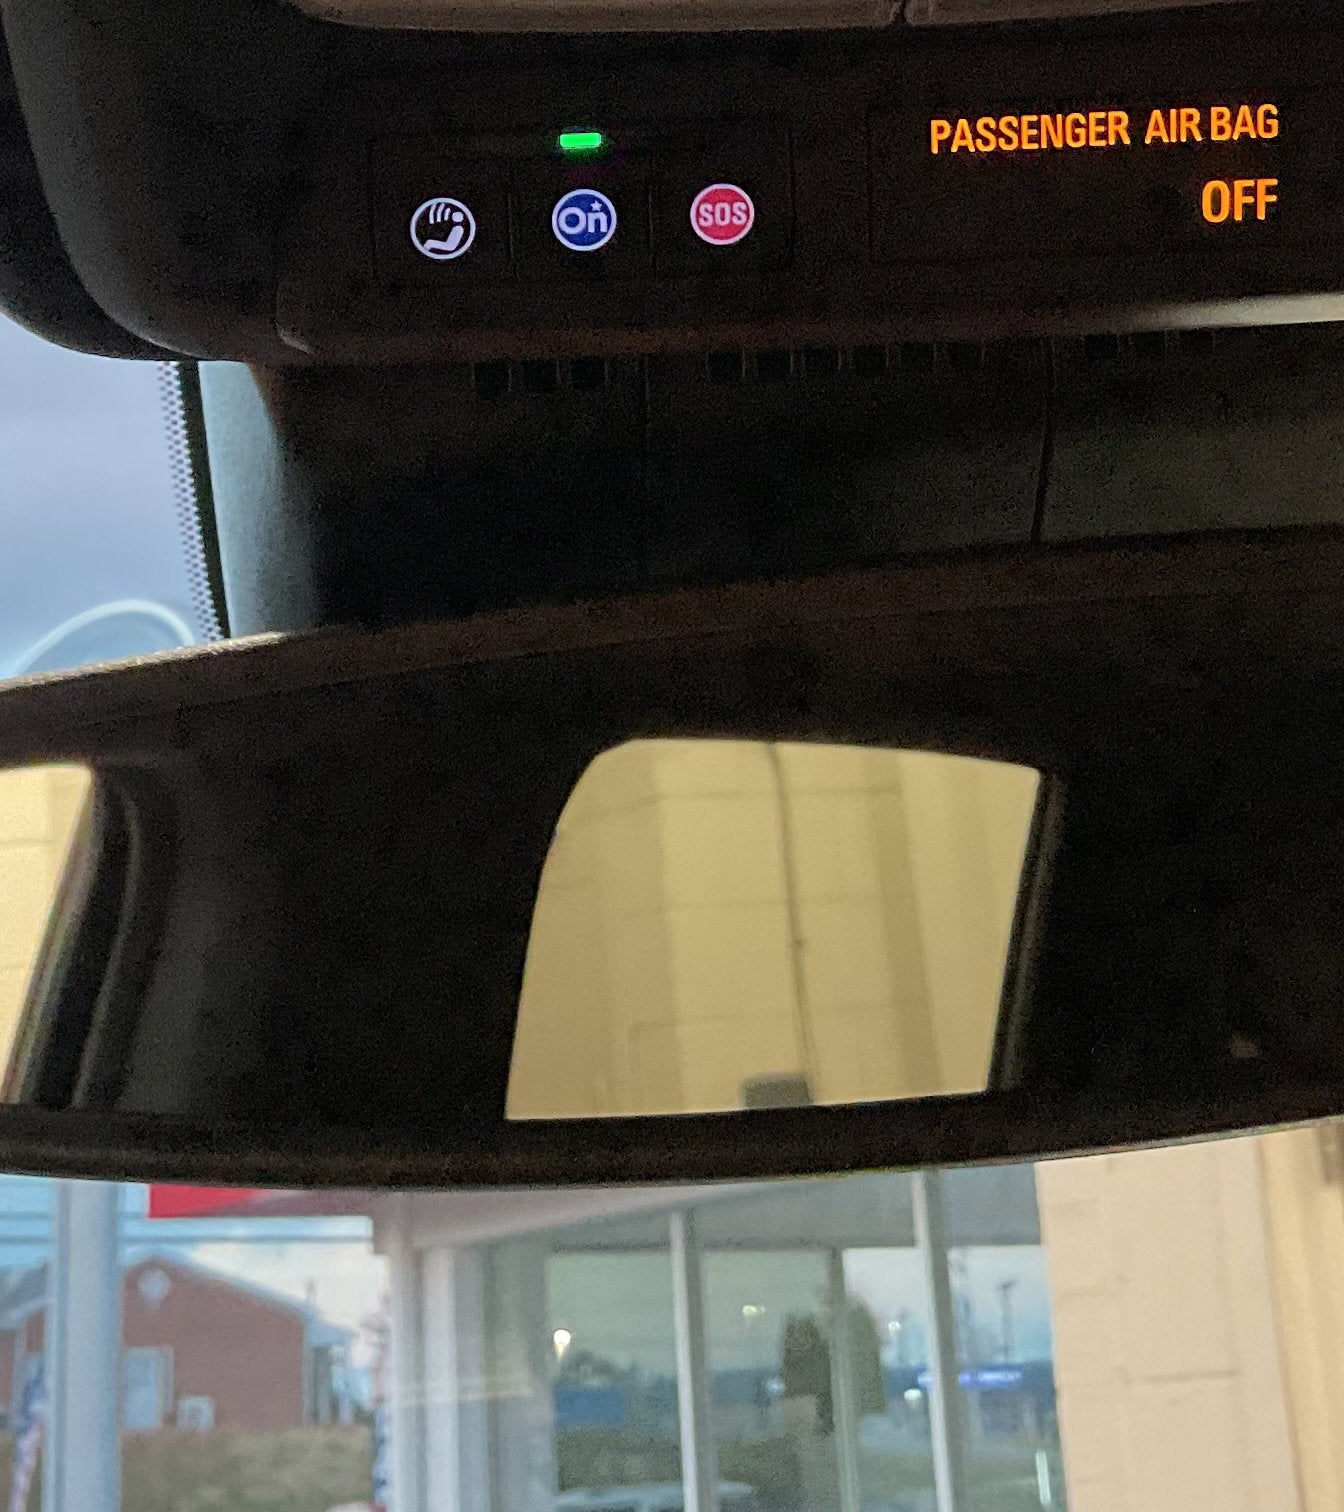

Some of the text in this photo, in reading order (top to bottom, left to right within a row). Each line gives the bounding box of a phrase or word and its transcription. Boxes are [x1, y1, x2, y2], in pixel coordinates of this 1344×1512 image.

[930, 103, 1280, 155] PASSENGER AIR BAG
[556, 204, 608, 235] On
[697, 201, 748, 228] SOS
[1200, 176, 1280, 225] OFF
